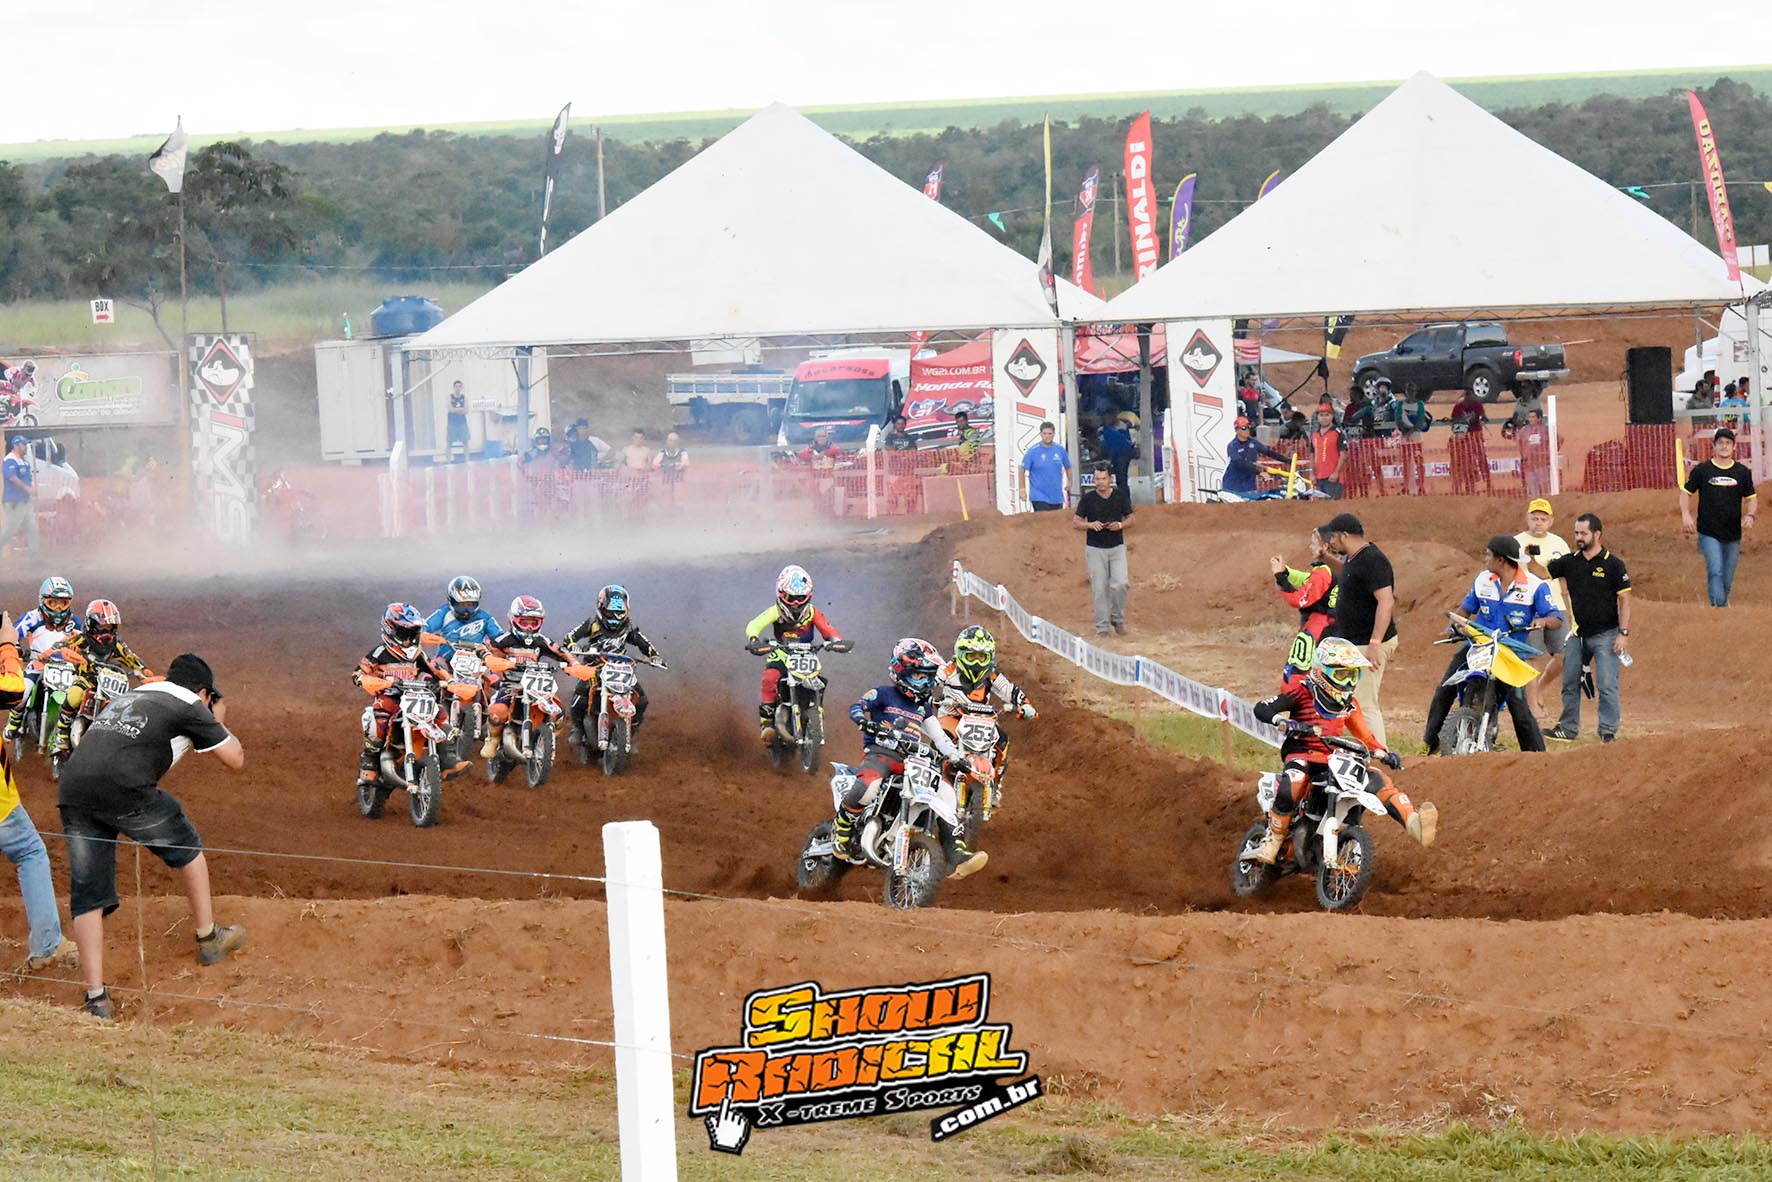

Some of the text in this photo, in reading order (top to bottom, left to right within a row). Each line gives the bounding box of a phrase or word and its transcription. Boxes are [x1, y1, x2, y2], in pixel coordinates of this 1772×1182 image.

[95, 301, 109, 312] BOX
[914, 381, 974, 392] Honda
[457, 657, 481, 675] 21
[789, 659, 817, 672] 360
[525, 676, 553, 691] 712
[405, 697, 434, 714] 711
[962, 724, 994, 743] 253
[1336, 758, 1366, 783] 74
[911, 766, 940, 793] 294
